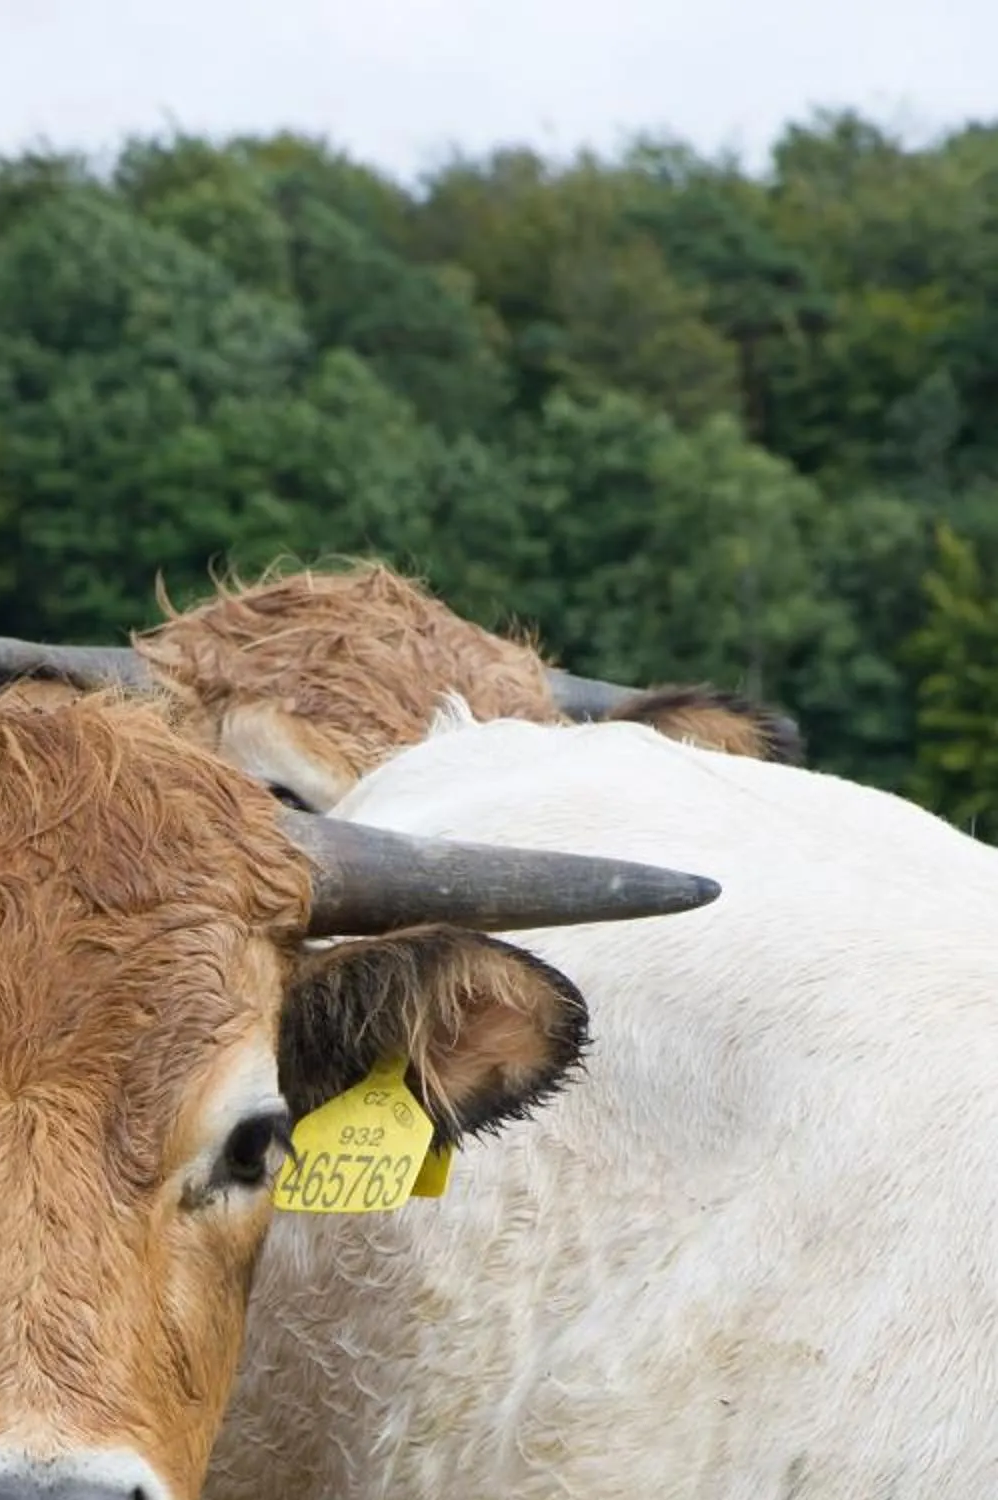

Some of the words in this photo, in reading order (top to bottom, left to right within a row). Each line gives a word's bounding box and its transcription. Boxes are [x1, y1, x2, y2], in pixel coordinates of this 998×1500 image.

[363, 1090, 392, 1107] CZ
[338, 1125, 386, 1147] 932
[281, 1150, 413, 1208] 465763
